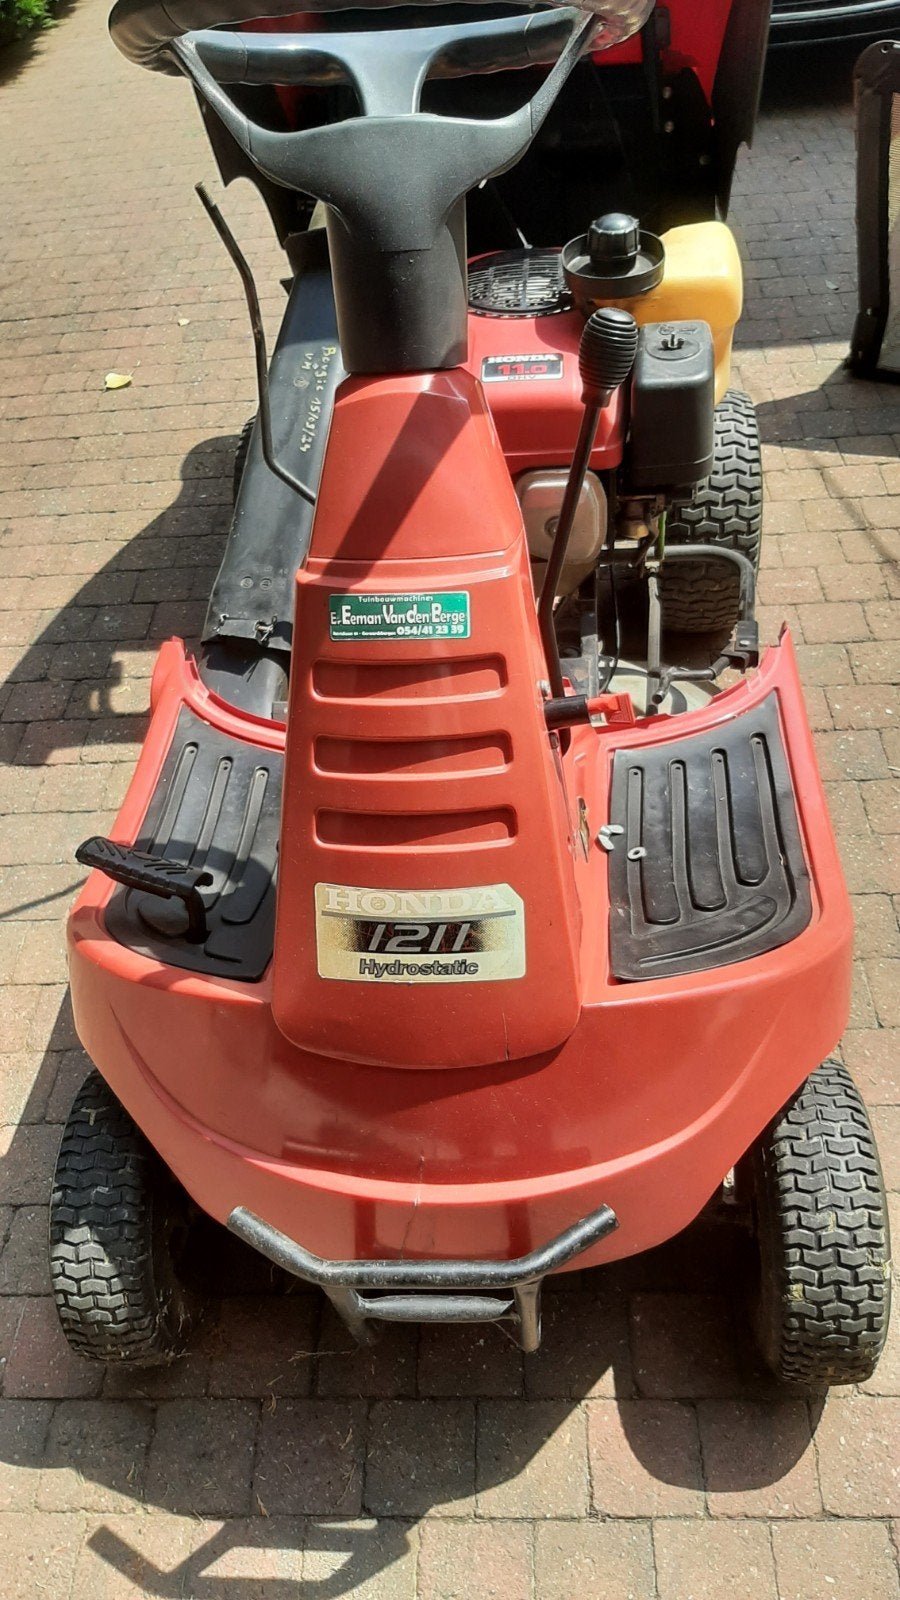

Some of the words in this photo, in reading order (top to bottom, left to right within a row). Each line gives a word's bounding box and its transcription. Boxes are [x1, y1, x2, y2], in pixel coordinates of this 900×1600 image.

[487, 354, 559, 364] HONDA
[497, 363, 548, 375] 11.0
[431, 602, 465, 625] Berge
[396, 625, 433, 635] 054/41
[435, 625, 448, 635] 23
[450, 624, 464, 634] 39
[325, 887, 511, 915] HONDA
[367, 923, 471, 952] 1211
[359, 958, 479, 978] Hydrostatic
